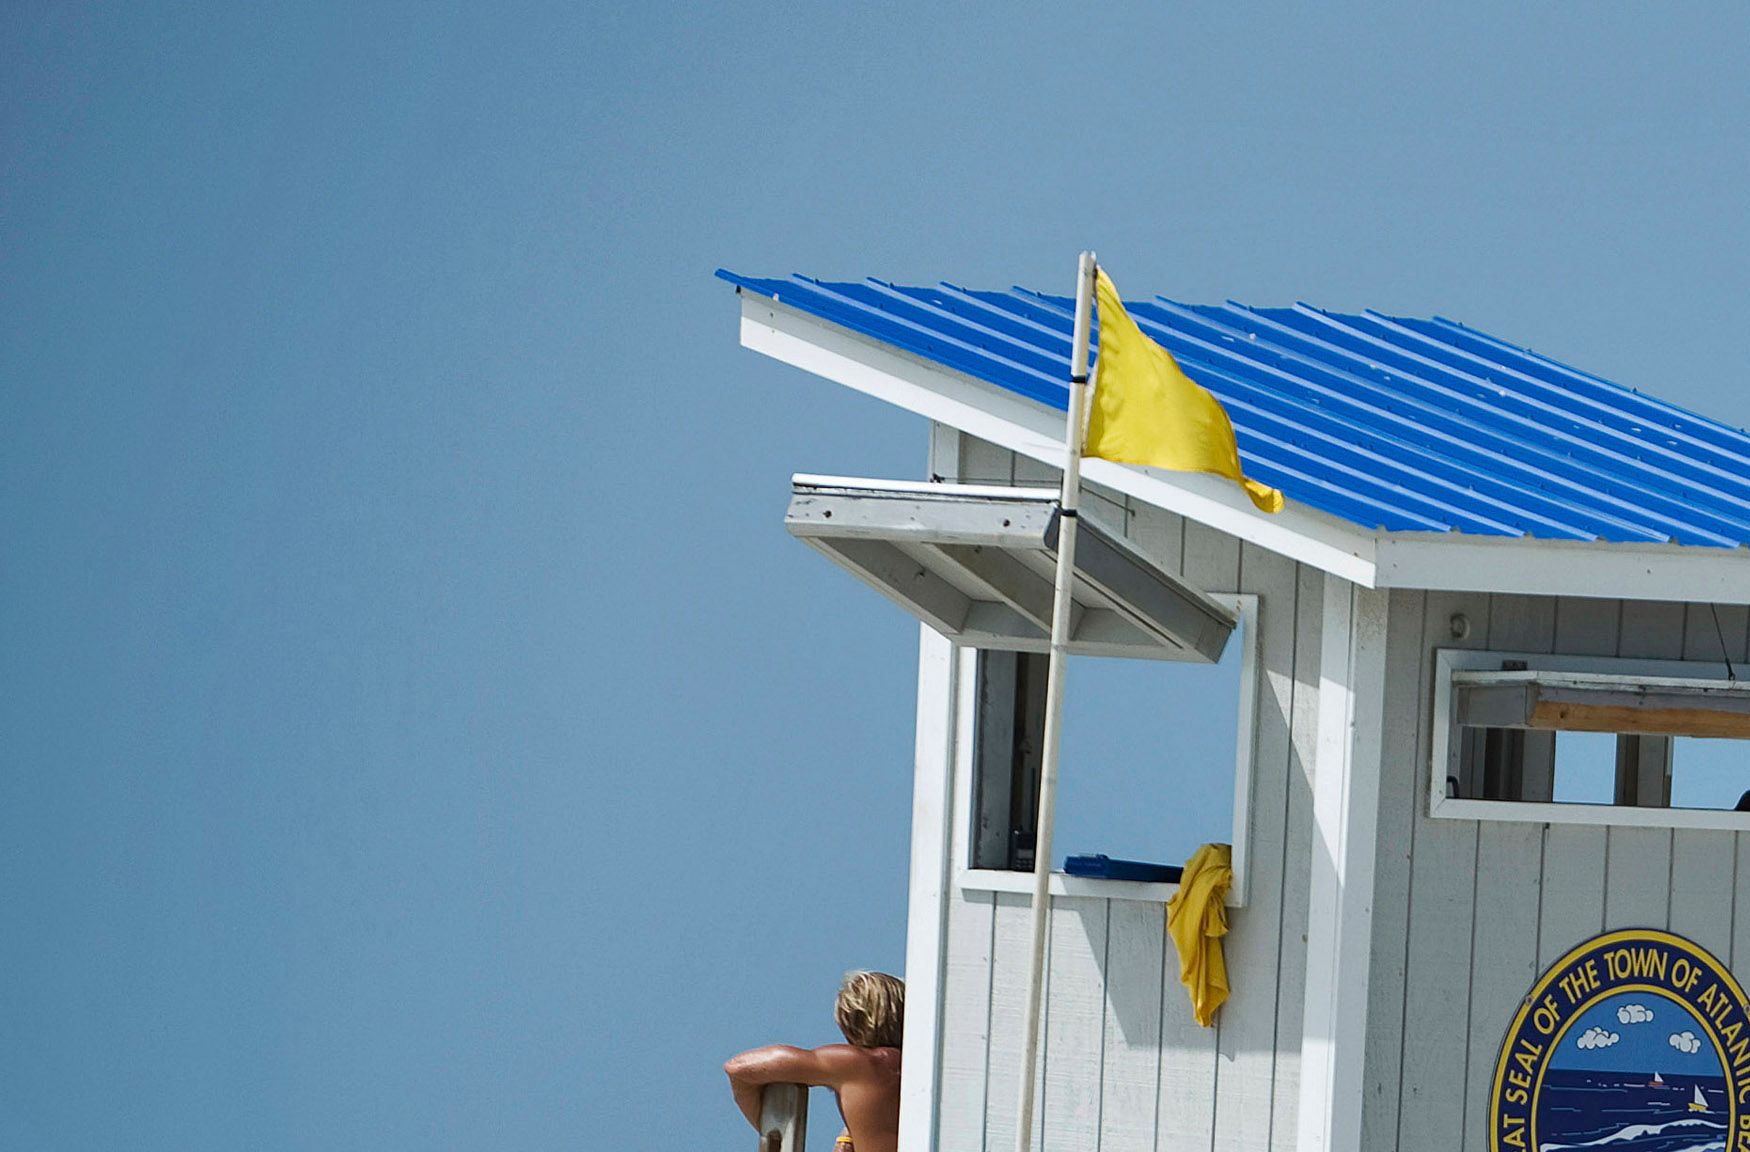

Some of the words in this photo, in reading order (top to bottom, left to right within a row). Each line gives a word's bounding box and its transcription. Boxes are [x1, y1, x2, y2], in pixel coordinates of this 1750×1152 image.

[1506, 1039, 1542, 1105] SEAL
[1533, 994, 1560, 1035] OF
[1558, 959, 1600, 1004] THE
[1604, 948, 1668, 981] TOWN
[1671, 958, 1702, 993] OF
